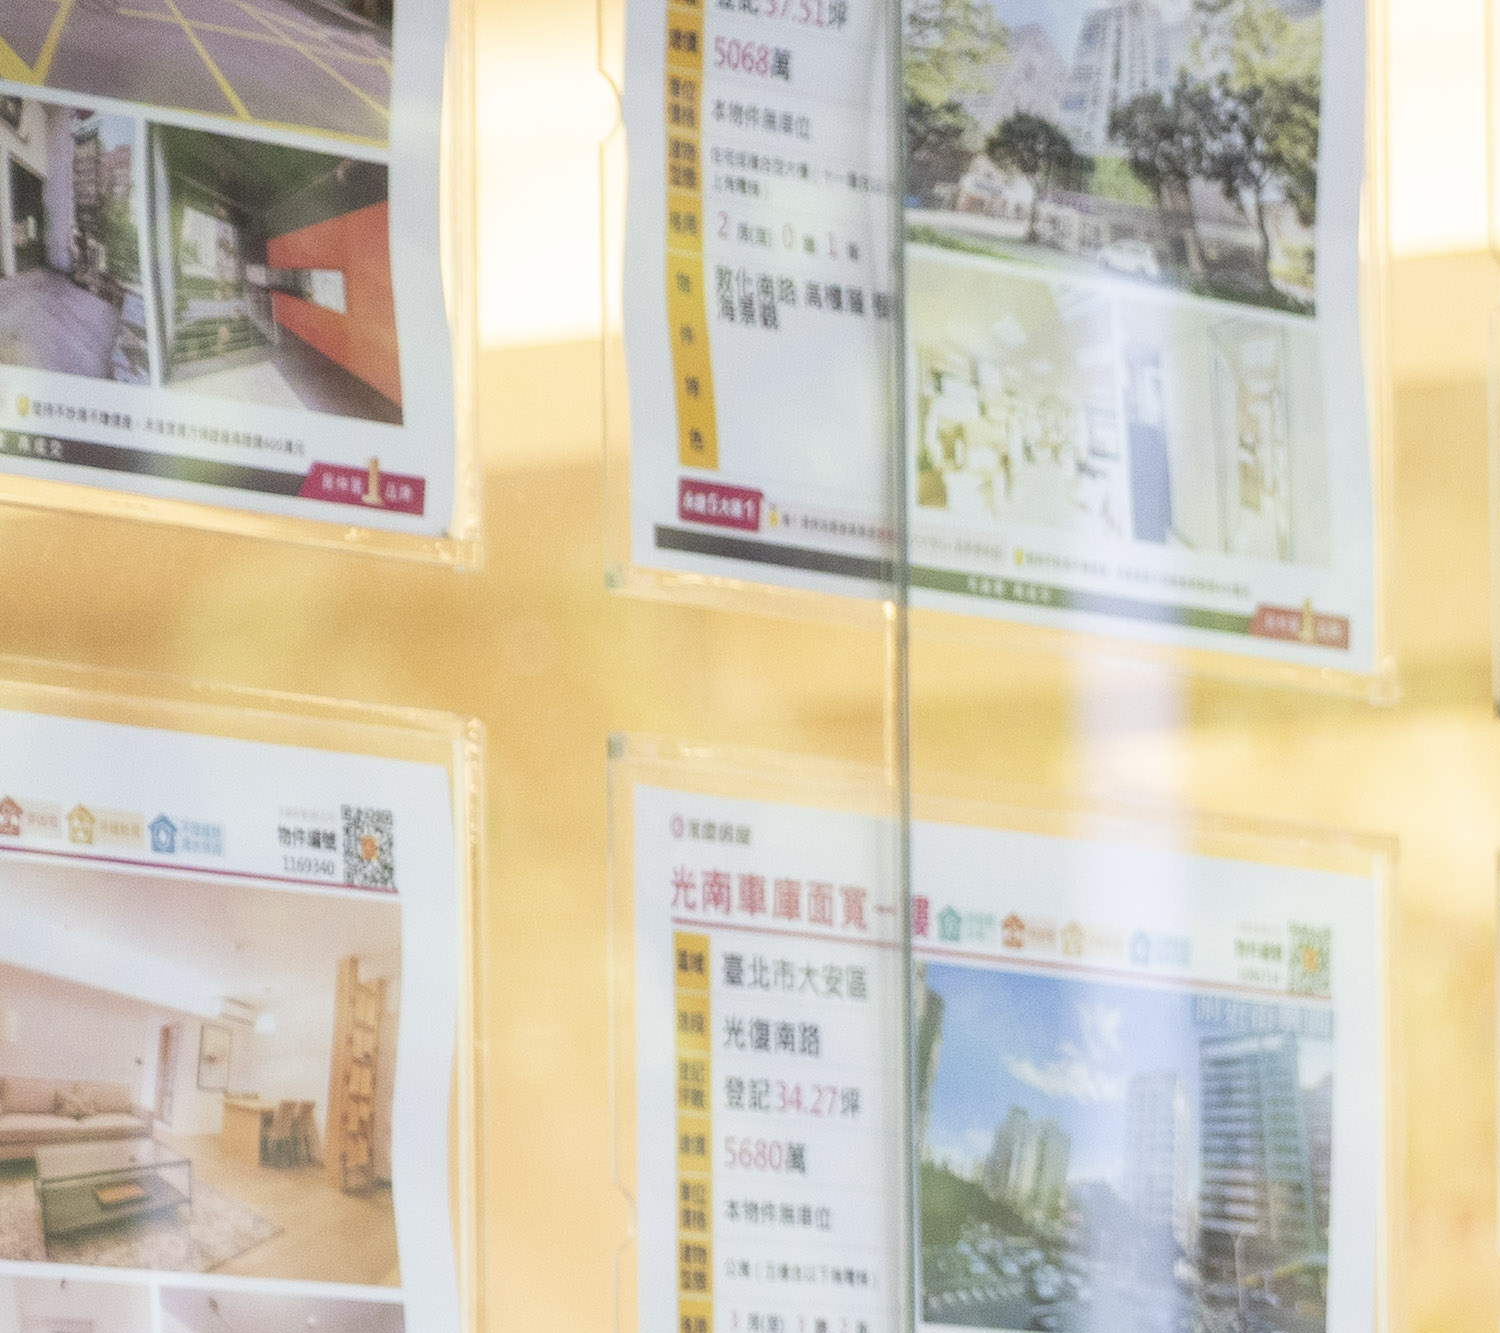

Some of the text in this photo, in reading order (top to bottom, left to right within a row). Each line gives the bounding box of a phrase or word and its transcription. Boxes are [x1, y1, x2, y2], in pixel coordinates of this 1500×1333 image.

[721, 951, 869, 1001] 臺北市大安區
[722, 1015, 822, 1061] 光復南路
[722, 1074, 863, 1120] 登記34.27坪
[723, 1136, 806, 1176] 5680萬
